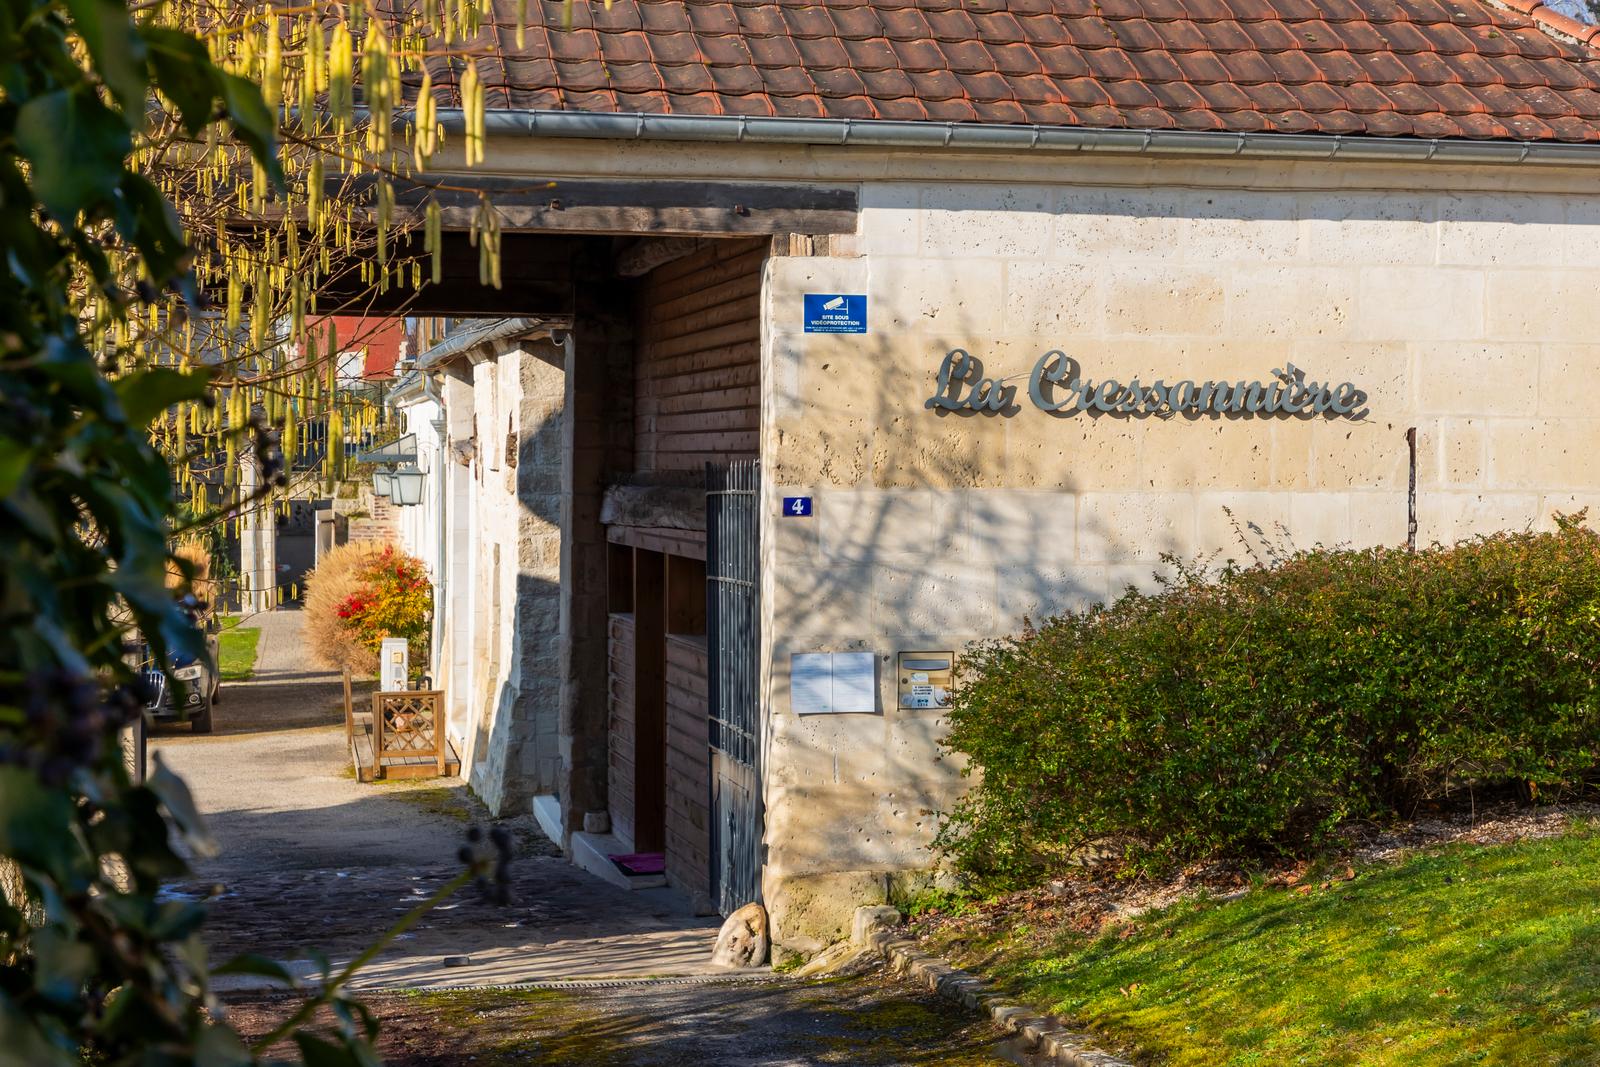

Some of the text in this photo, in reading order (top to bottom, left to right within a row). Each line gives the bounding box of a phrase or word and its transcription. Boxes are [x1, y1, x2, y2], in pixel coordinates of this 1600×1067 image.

[924, 348, 1358, 414] La Cressonnière
[792, 499, 804, 514] 4
